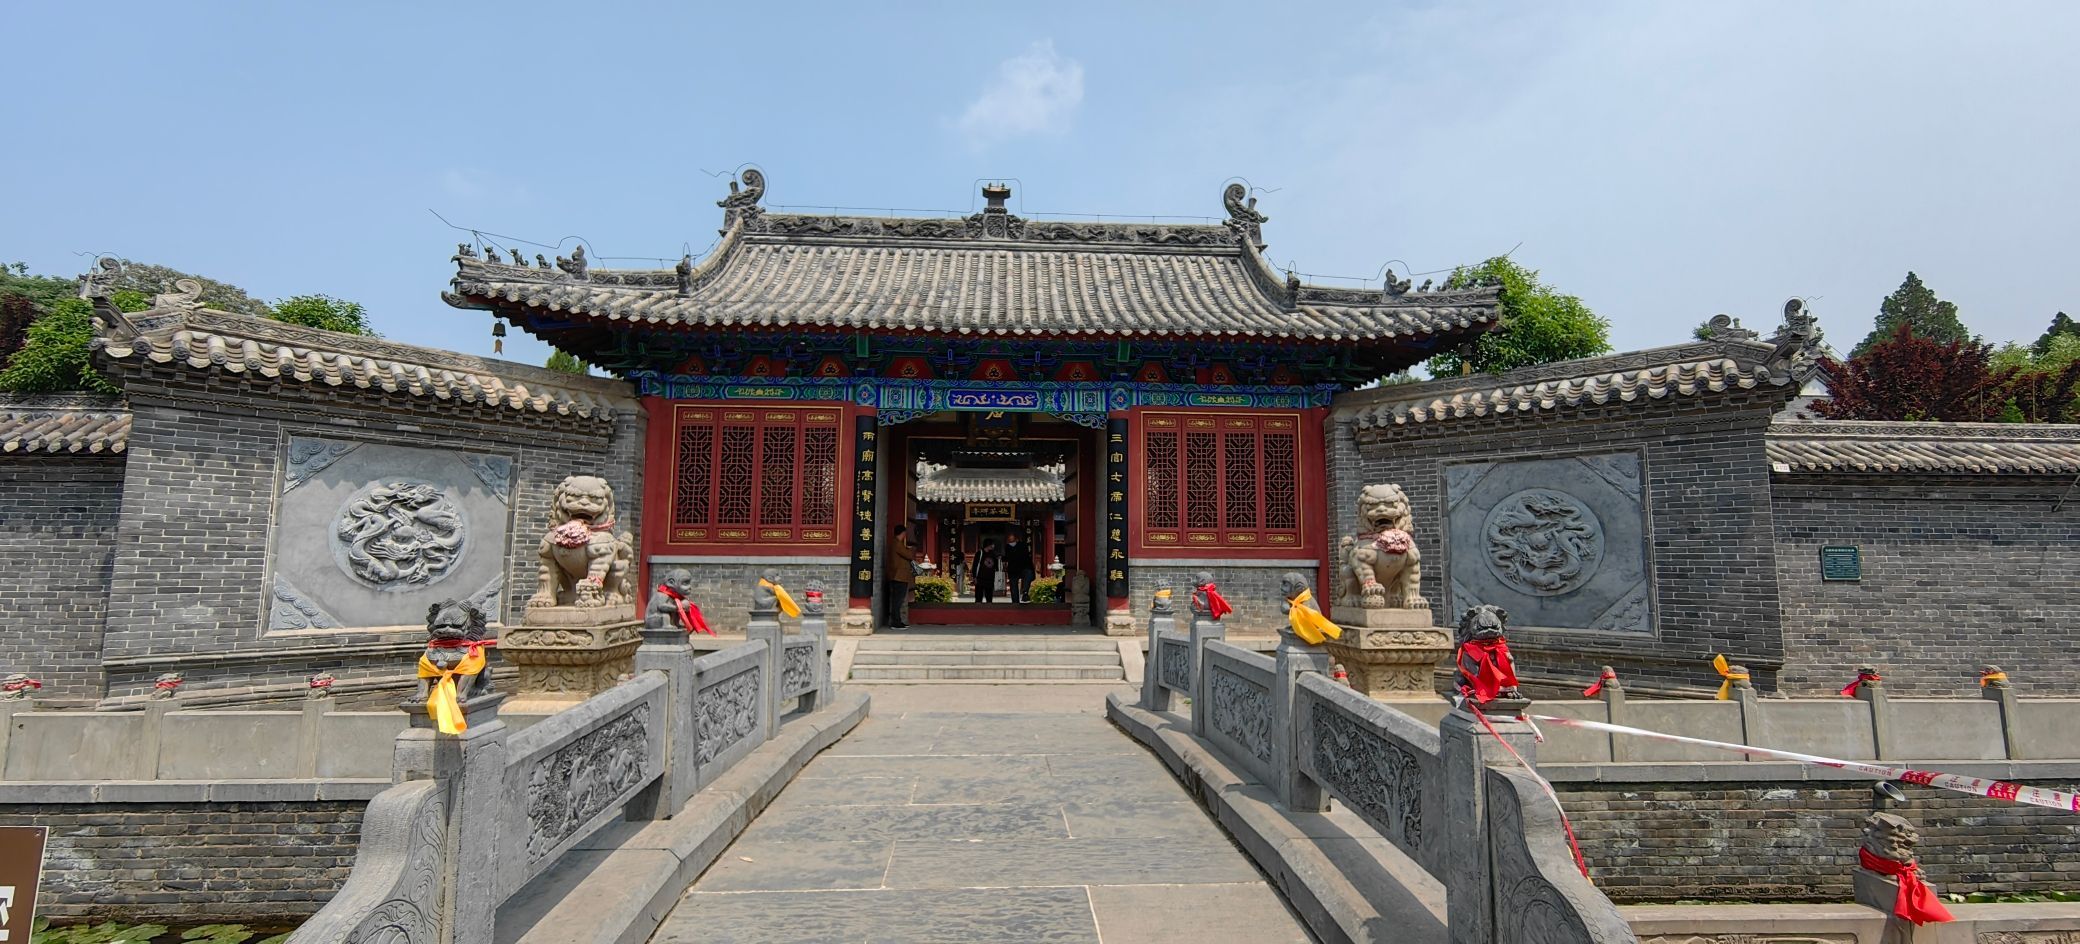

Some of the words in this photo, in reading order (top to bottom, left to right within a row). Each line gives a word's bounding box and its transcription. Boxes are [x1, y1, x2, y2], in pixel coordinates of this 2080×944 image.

[1858, 765, 1892, 777] CAUTION
[1944, 782, 1978, 793] CAUTION
[2029, 797, 2063, 808] CAUTION
